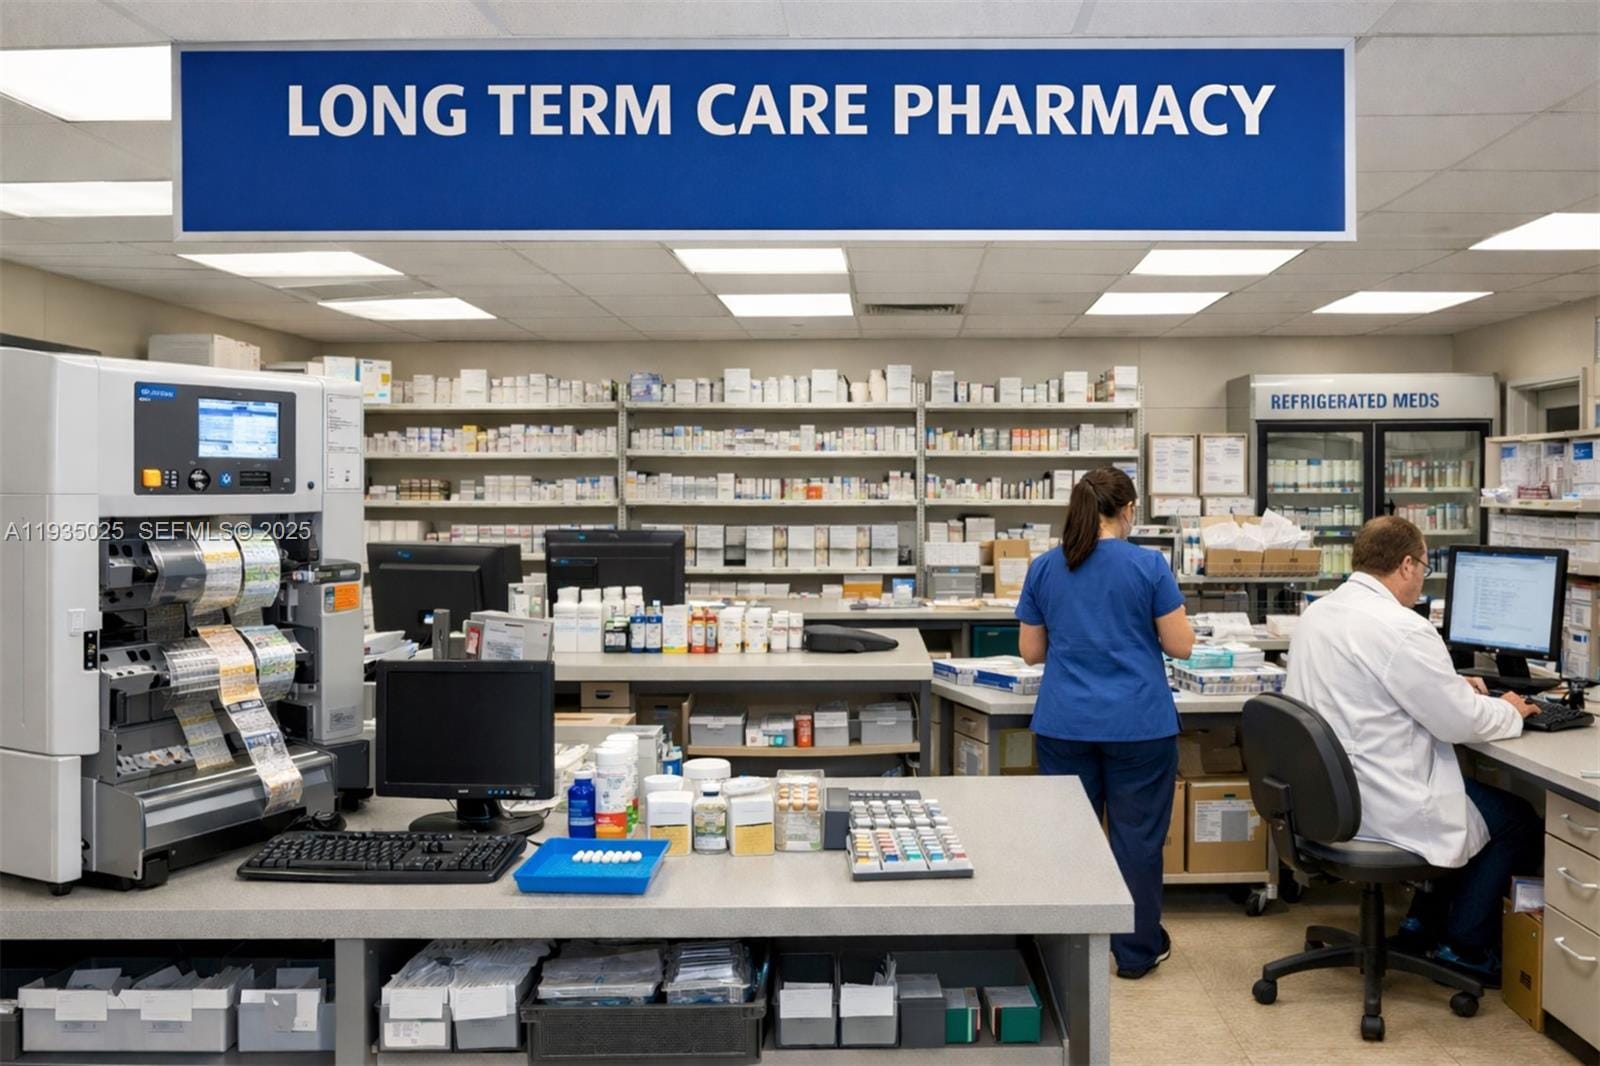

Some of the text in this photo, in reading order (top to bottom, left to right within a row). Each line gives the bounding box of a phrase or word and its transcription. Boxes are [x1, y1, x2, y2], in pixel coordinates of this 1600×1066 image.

[288, 83, 1276, 137] LONG TERM CARE PHARMACY
[1270, 393, 1440, 410] REFRIGERATED MEDS
